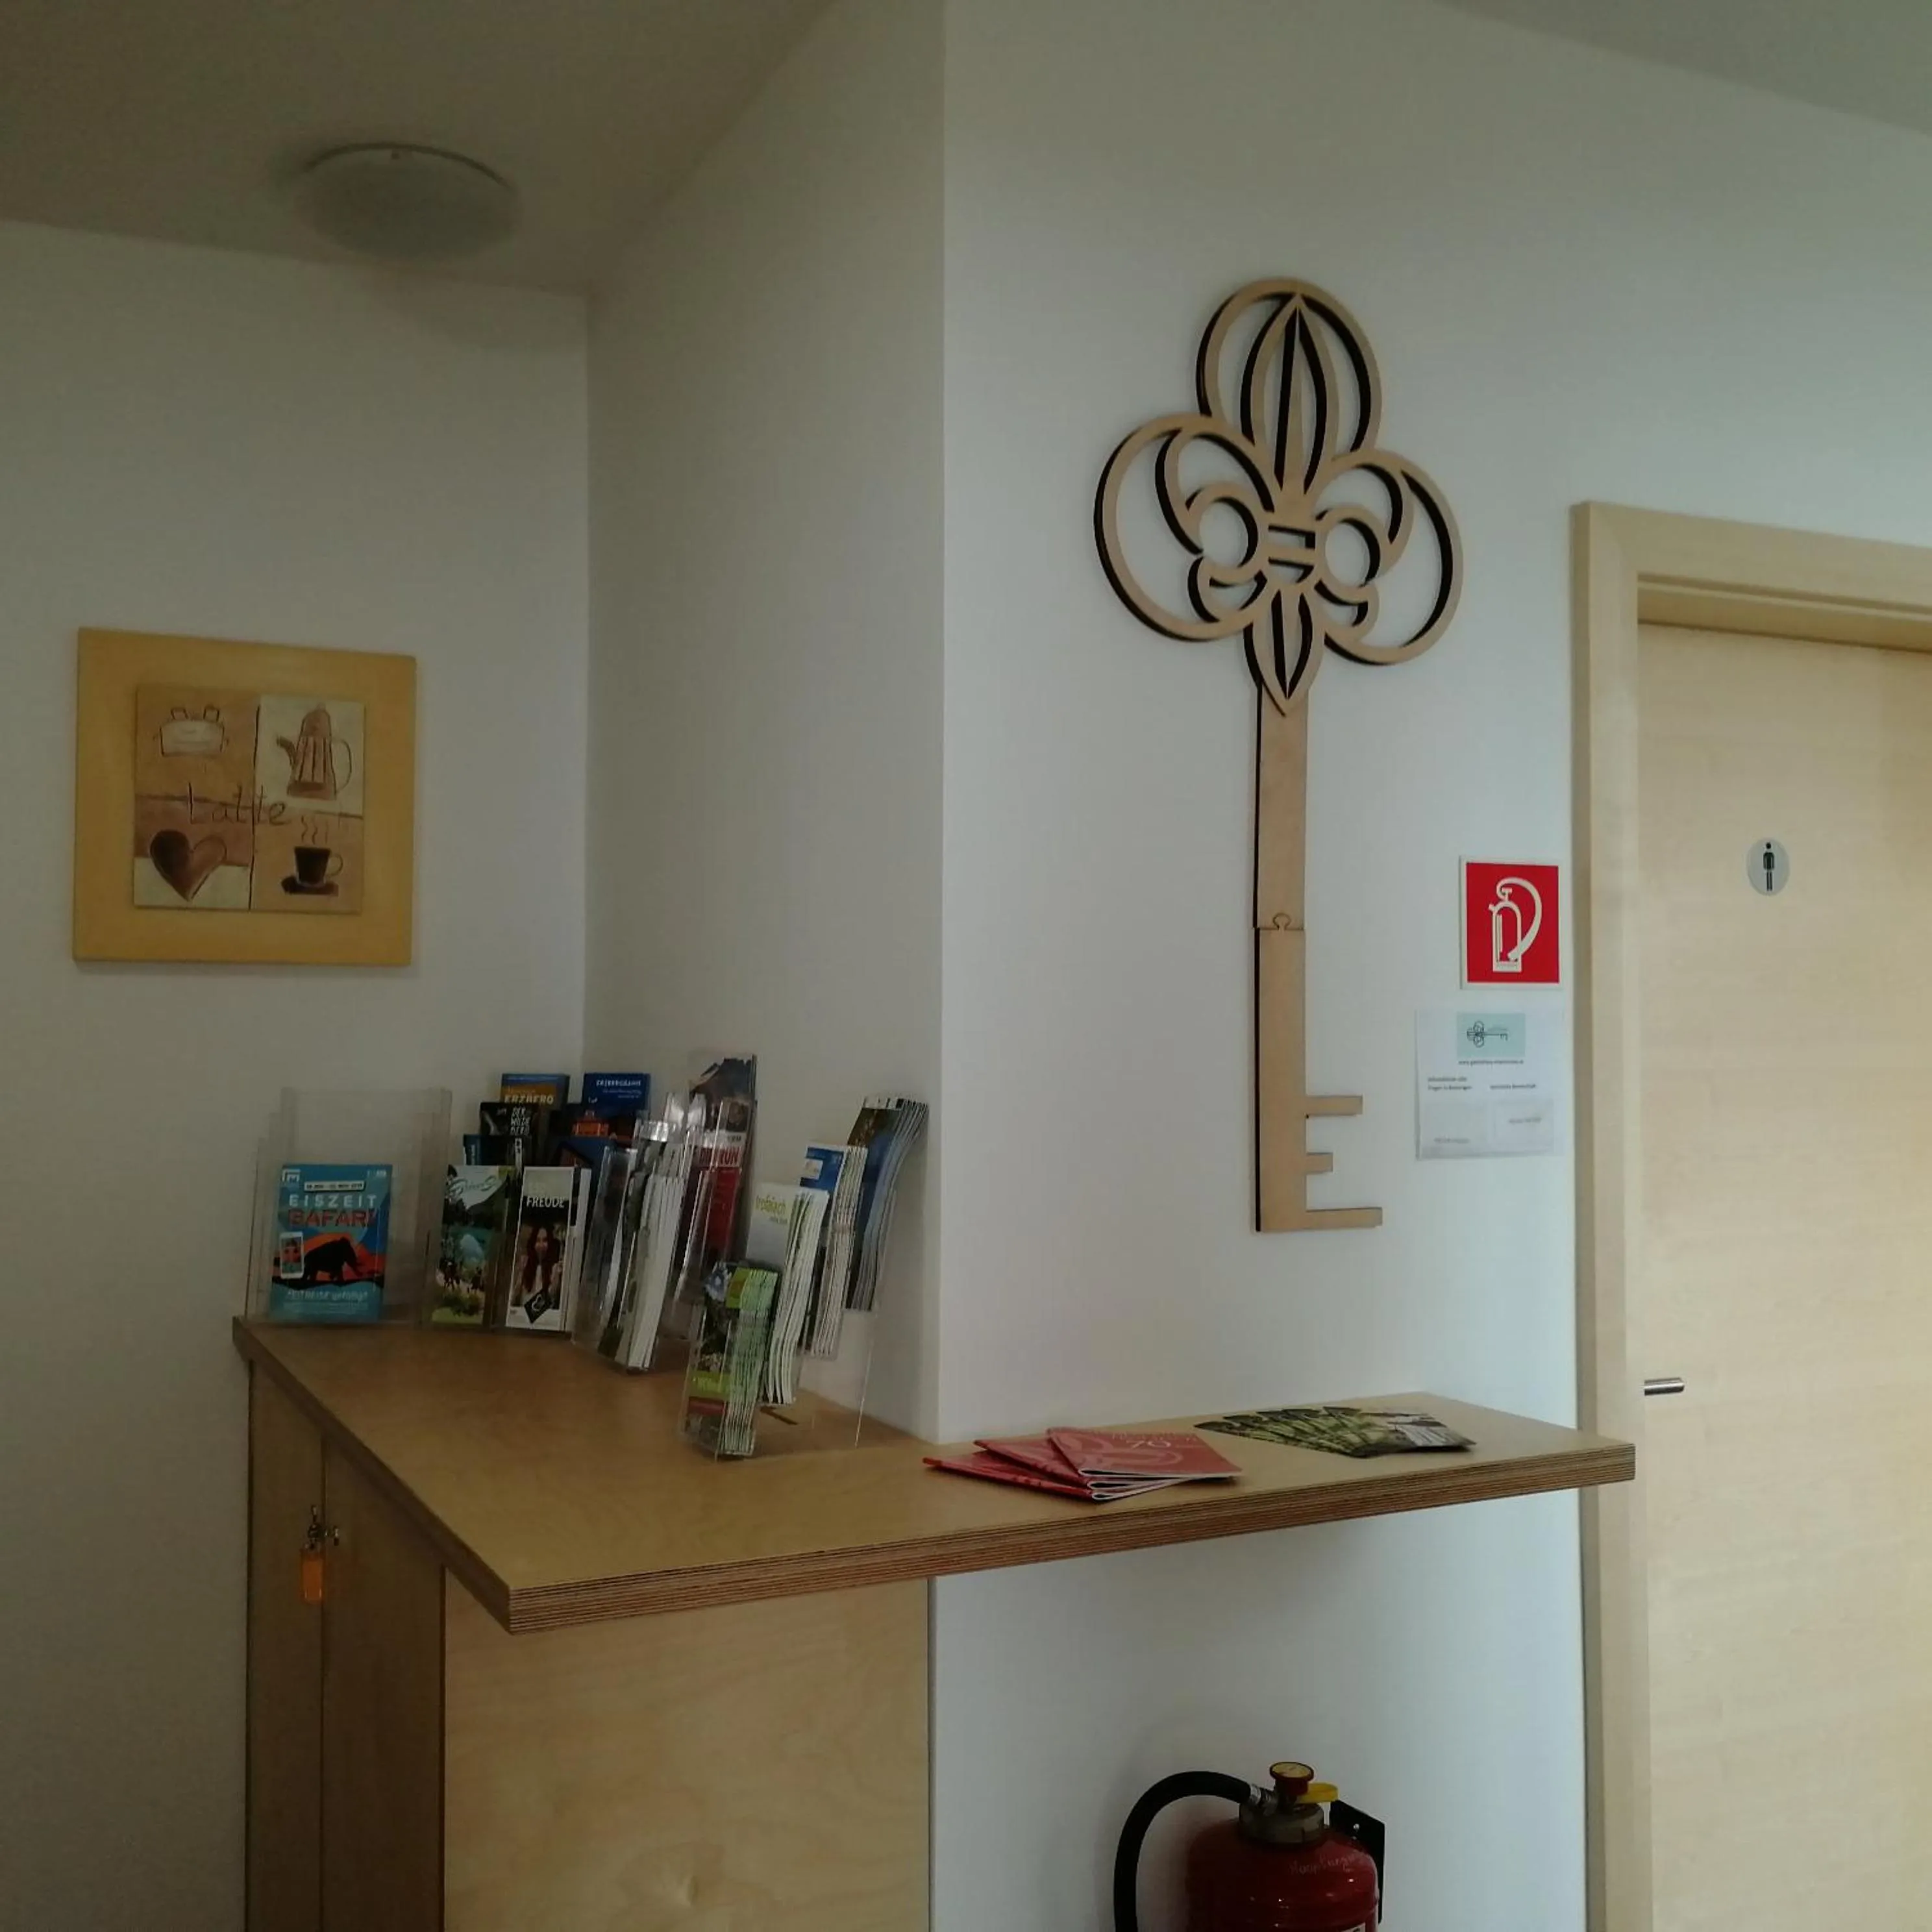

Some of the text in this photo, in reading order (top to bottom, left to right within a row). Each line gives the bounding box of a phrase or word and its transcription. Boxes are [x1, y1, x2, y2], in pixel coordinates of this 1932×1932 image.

[188, 782, 291, 826] Latte
[288, 1193, 378, 1208] EISZEIT
[526, 1195, 565, 1208] FREUDE
[288, 1208, 378, 1228] SAFARI
